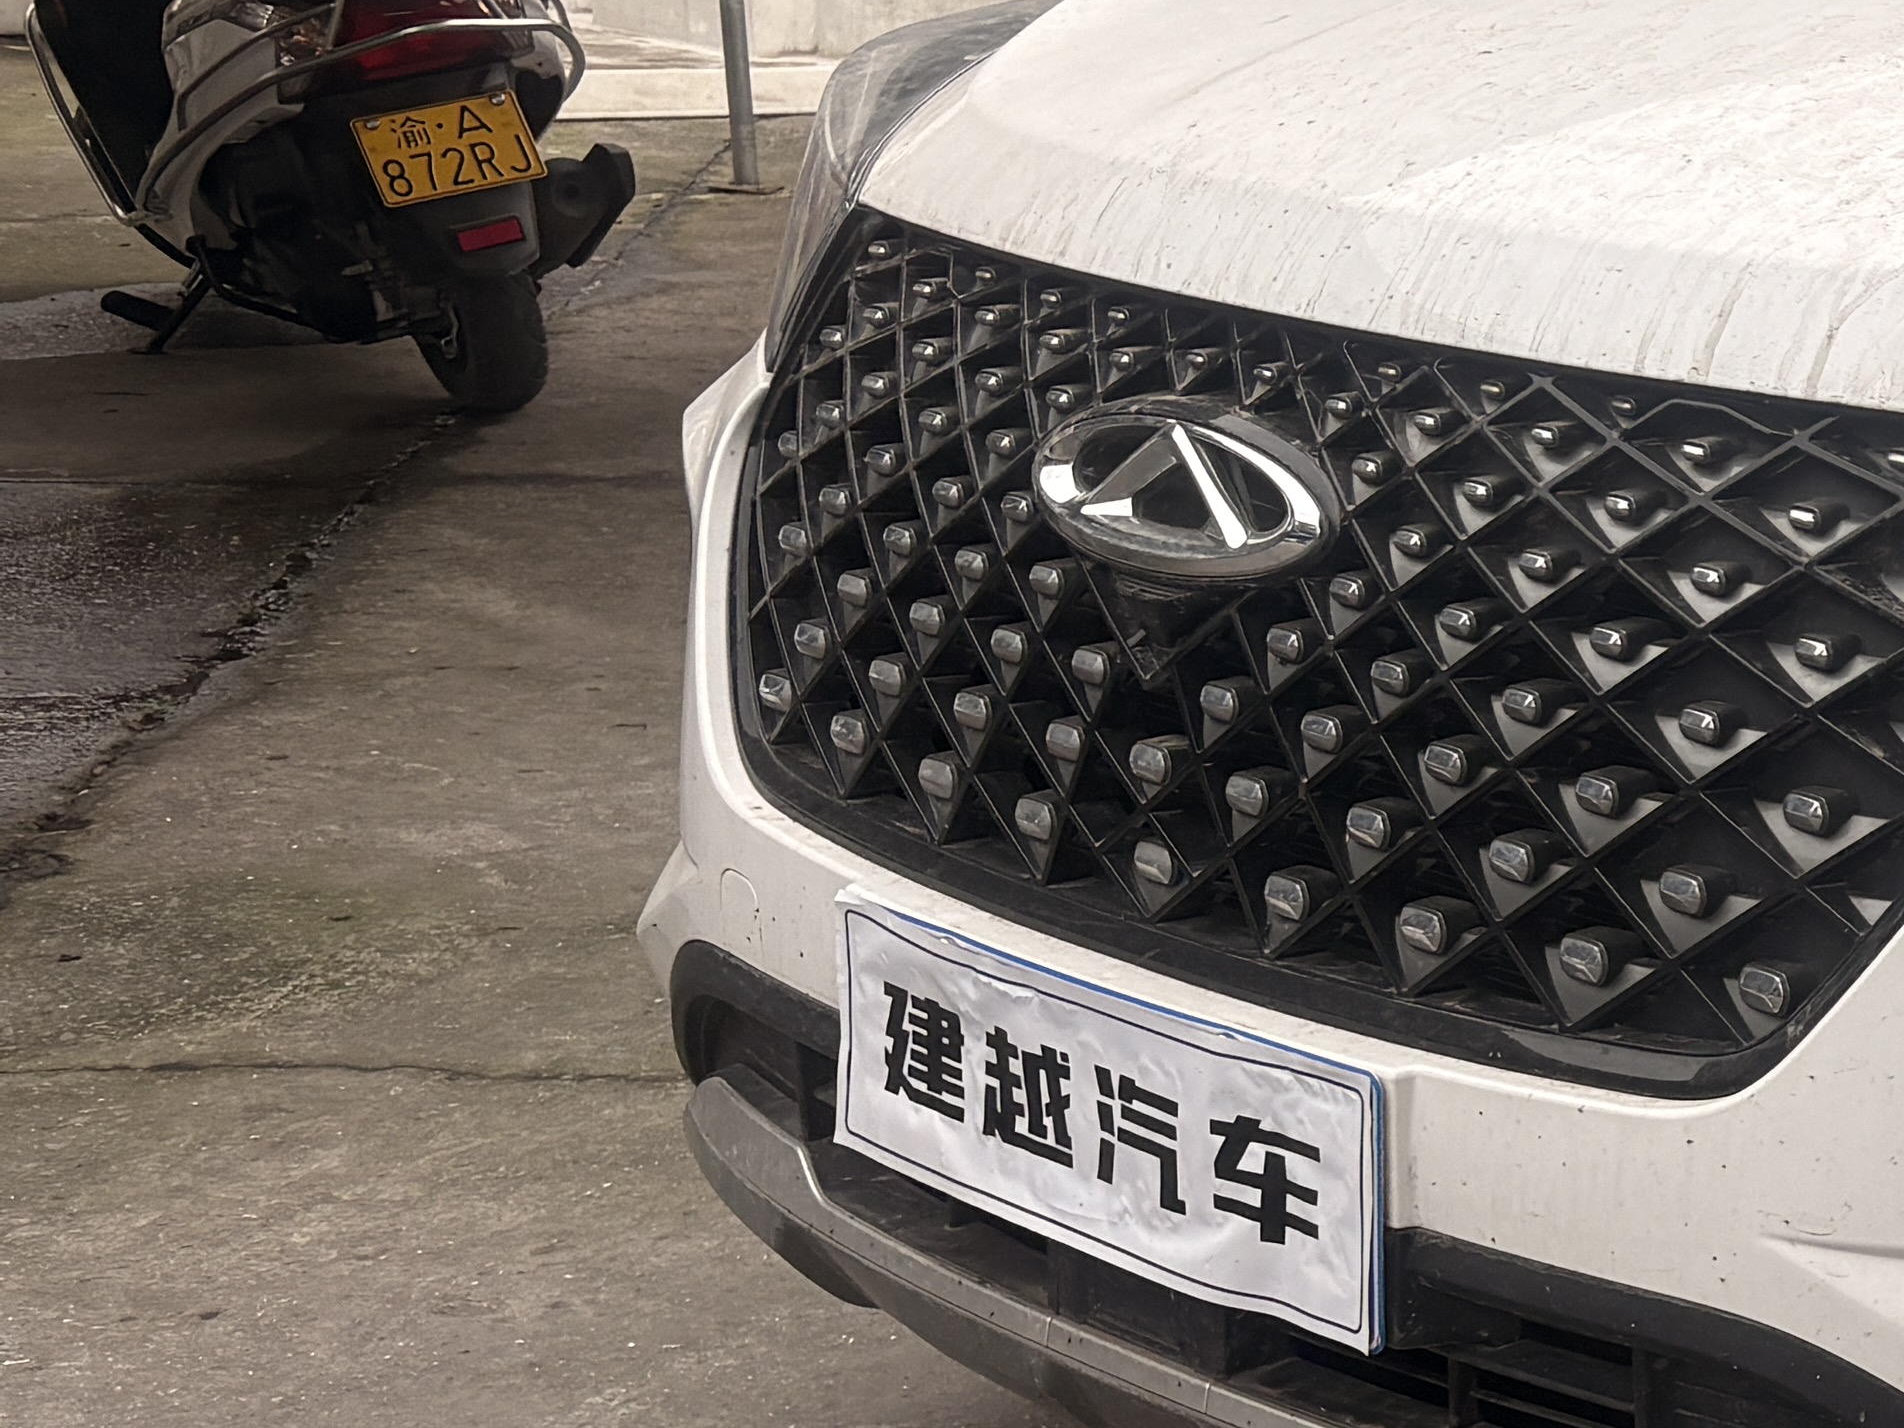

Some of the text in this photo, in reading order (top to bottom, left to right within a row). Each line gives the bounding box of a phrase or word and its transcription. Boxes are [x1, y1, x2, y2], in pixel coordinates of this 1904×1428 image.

[382, 134, 533, 198] 872RJ
[881, 980, 1322, 1246] 建越汽车
